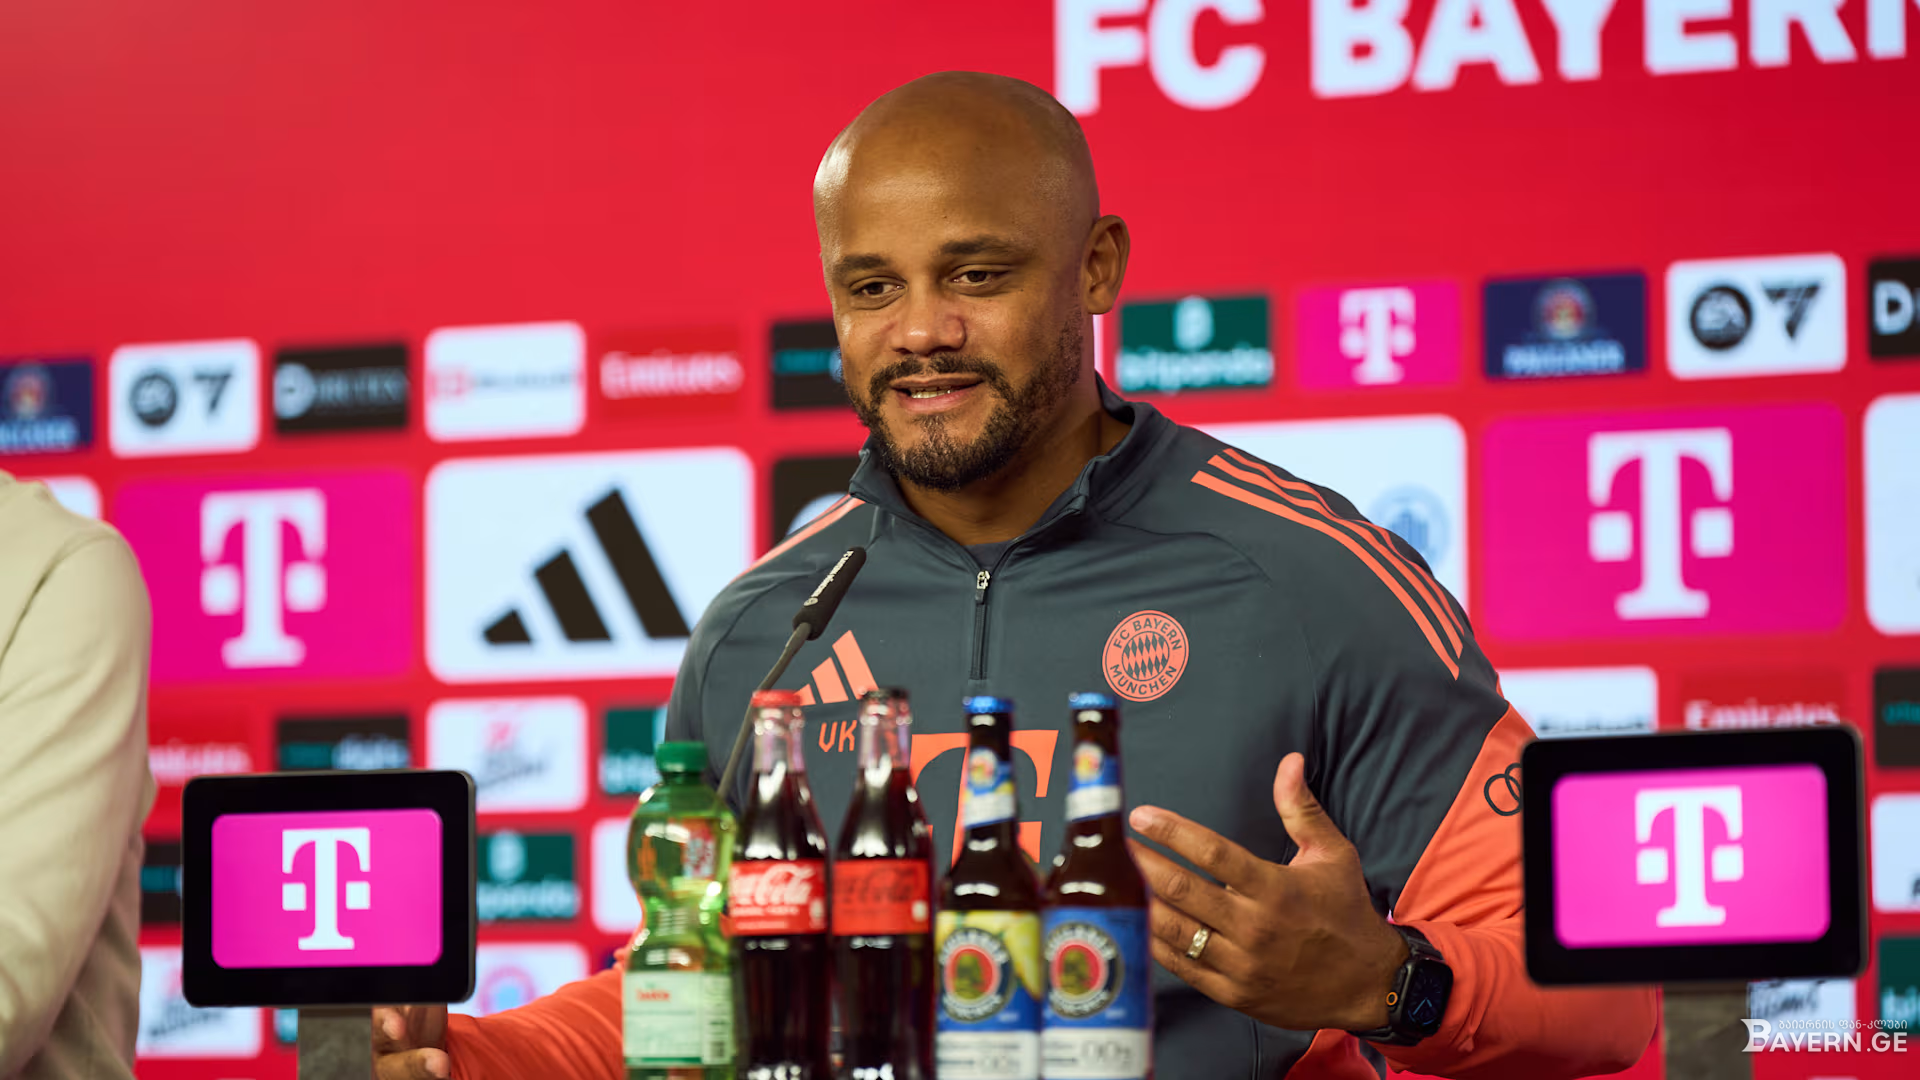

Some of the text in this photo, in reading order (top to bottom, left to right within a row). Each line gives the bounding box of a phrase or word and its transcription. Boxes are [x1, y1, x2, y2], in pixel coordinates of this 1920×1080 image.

[1053, 0, 1266, 117] FC
[200, 488, 327, 668] T
[1588, 427, 1733, 620] T
[1113, 617, 1183, 651] FC BAYERN
[818, 720, 857, 753] VK
[282, 827, 370, 950] T
[1634, 785, 1744, 928] T
